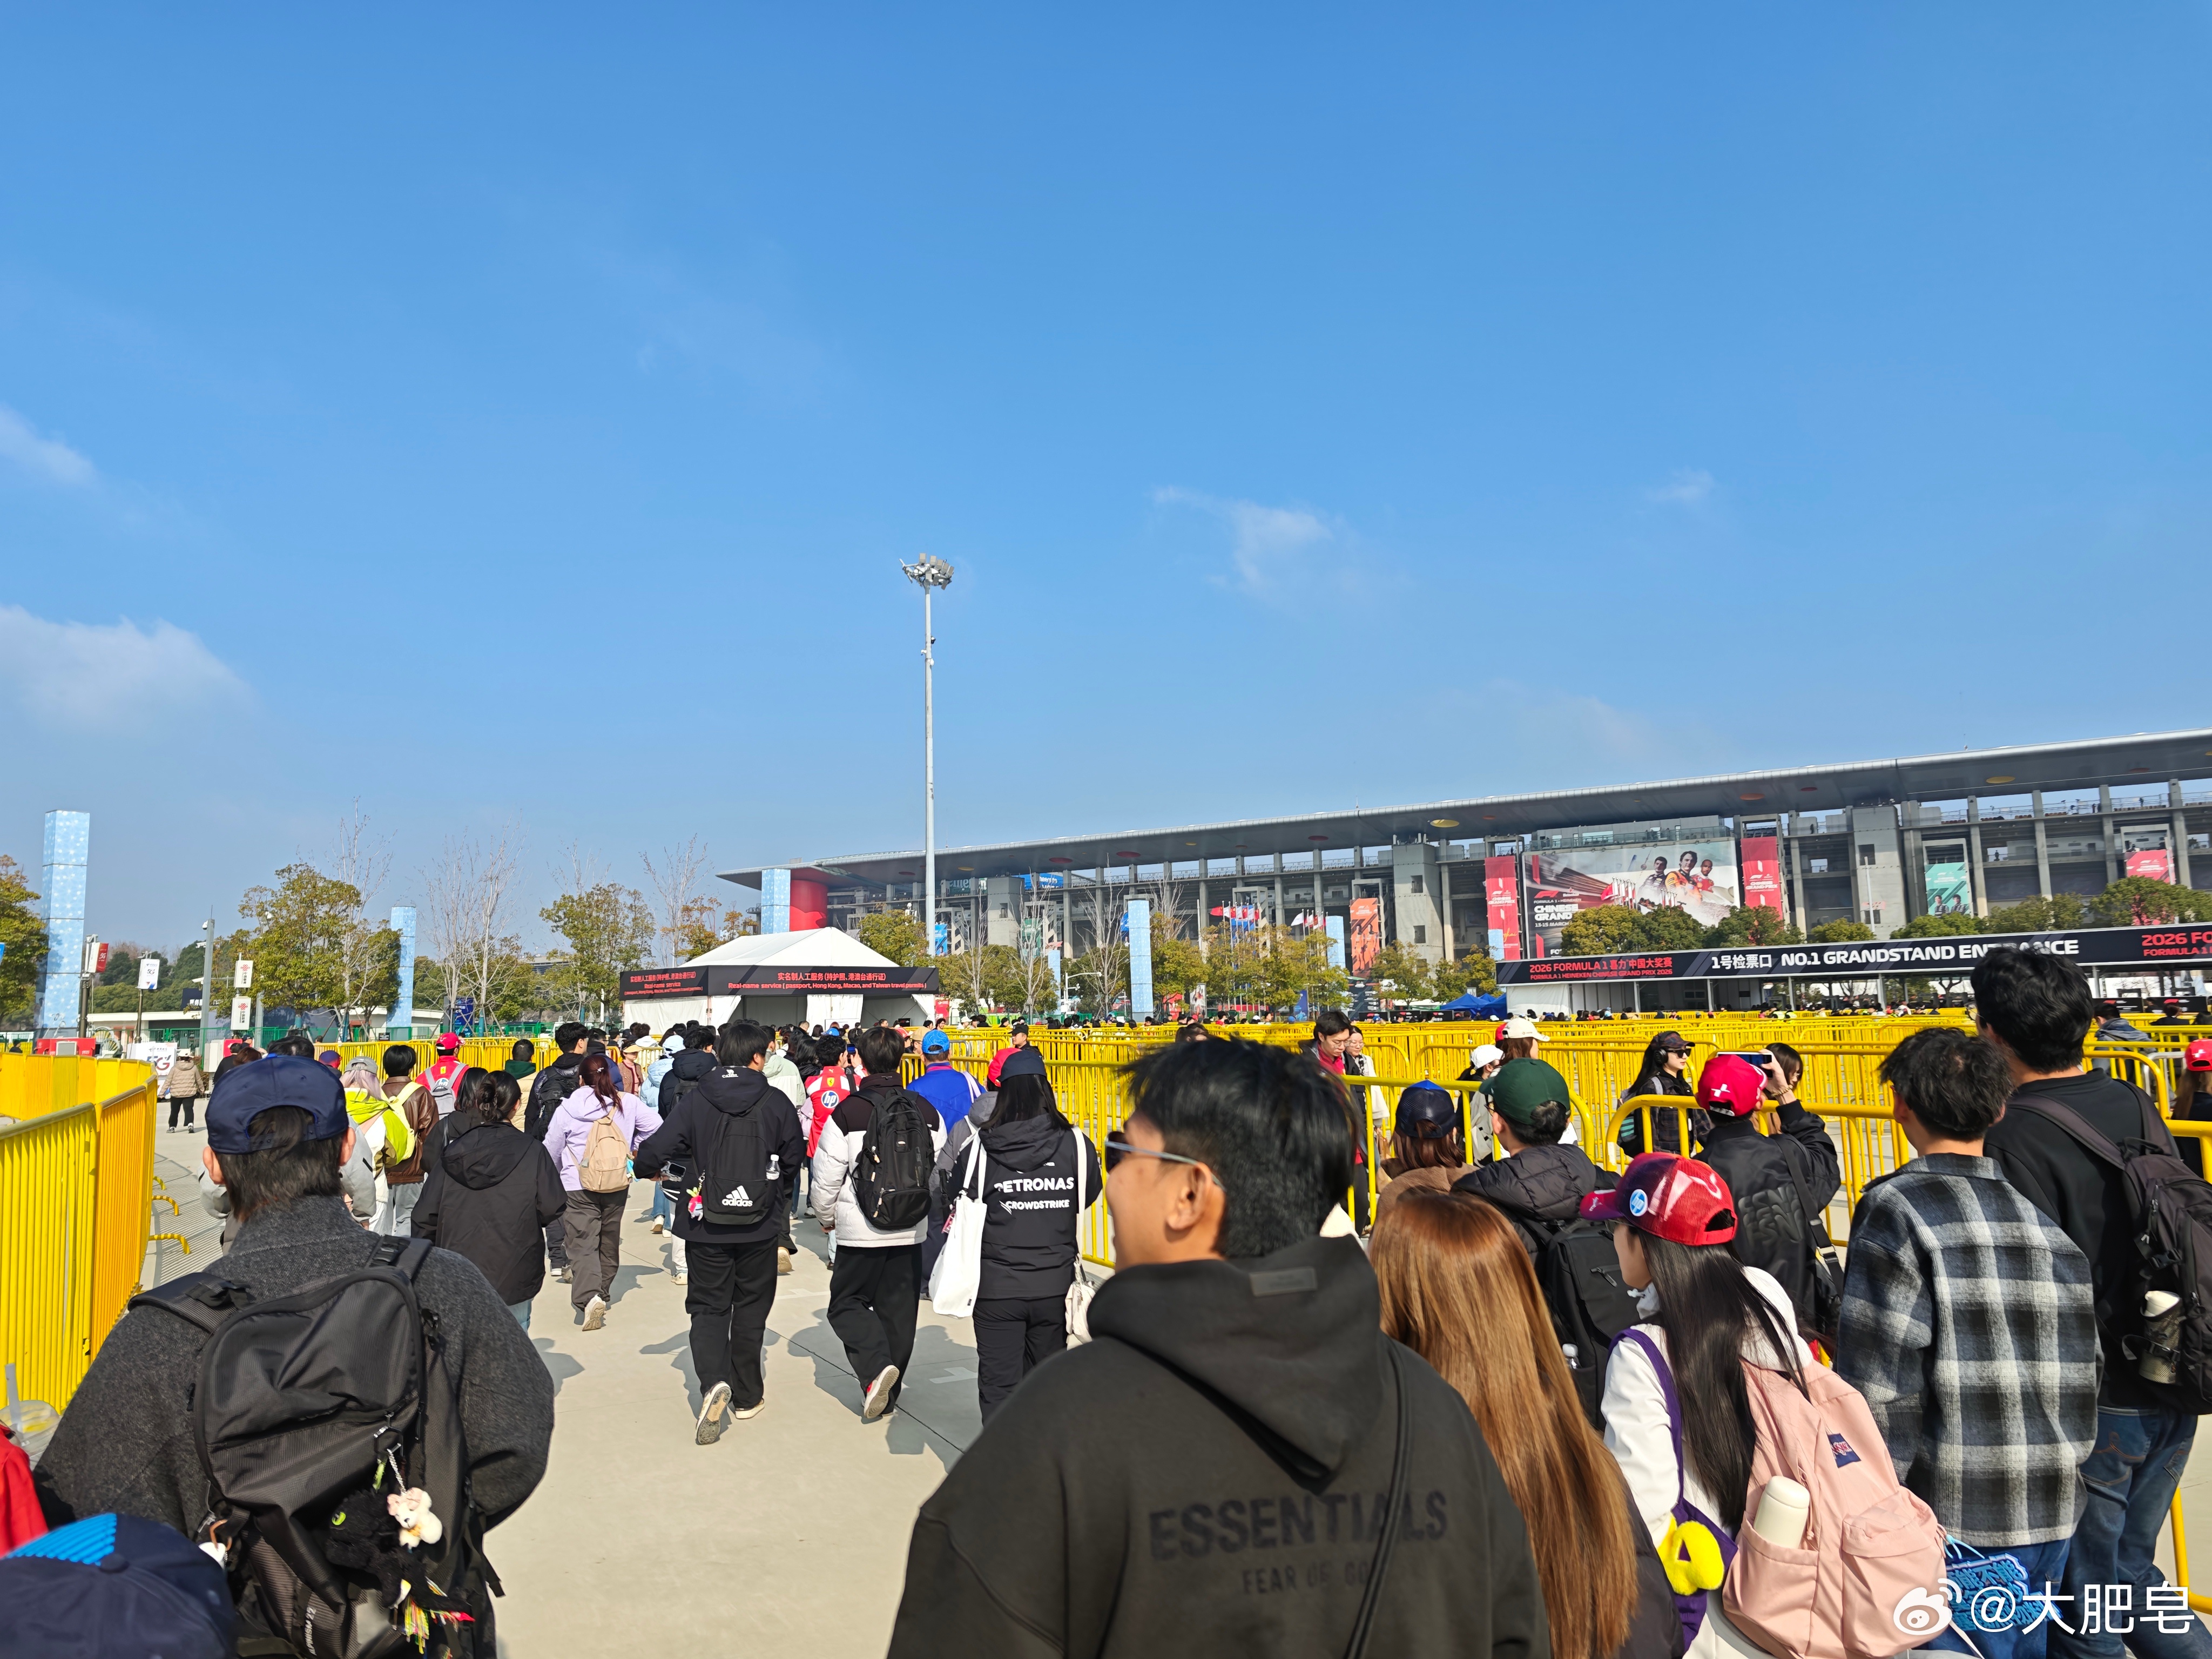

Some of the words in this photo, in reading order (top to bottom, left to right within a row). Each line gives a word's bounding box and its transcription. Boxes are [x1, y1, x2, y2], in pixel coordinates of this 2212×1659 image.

[1534, 903, 1579, 913] CHINESE
[1534, 912, 1573, 921] GRAND
[2141, 933, 2188, 946] 2026
[2143, 947, 2200, 956] FORMULA
[1711, 954, 1772, 970] 1号检票口
[1781, 952, 1821, 966] NO.1
[1823, 946, 1955, 965] GRANDSTAND
[1529, 964, 1552, 973] 2026
[1553, 961, 1602, 972] FORMULA
[1602, 961, 1608, 969] 1
[822, 1091, 838, 1108] hp
[721, 1198, 753, 1207] adidas
[1004, 1199, 1070, 1210] CROWDSTRIKE
[1148, 1489, 1449, 1562] ESSENTIALS
[1242, 1564, 1297, 1595] FEAR
